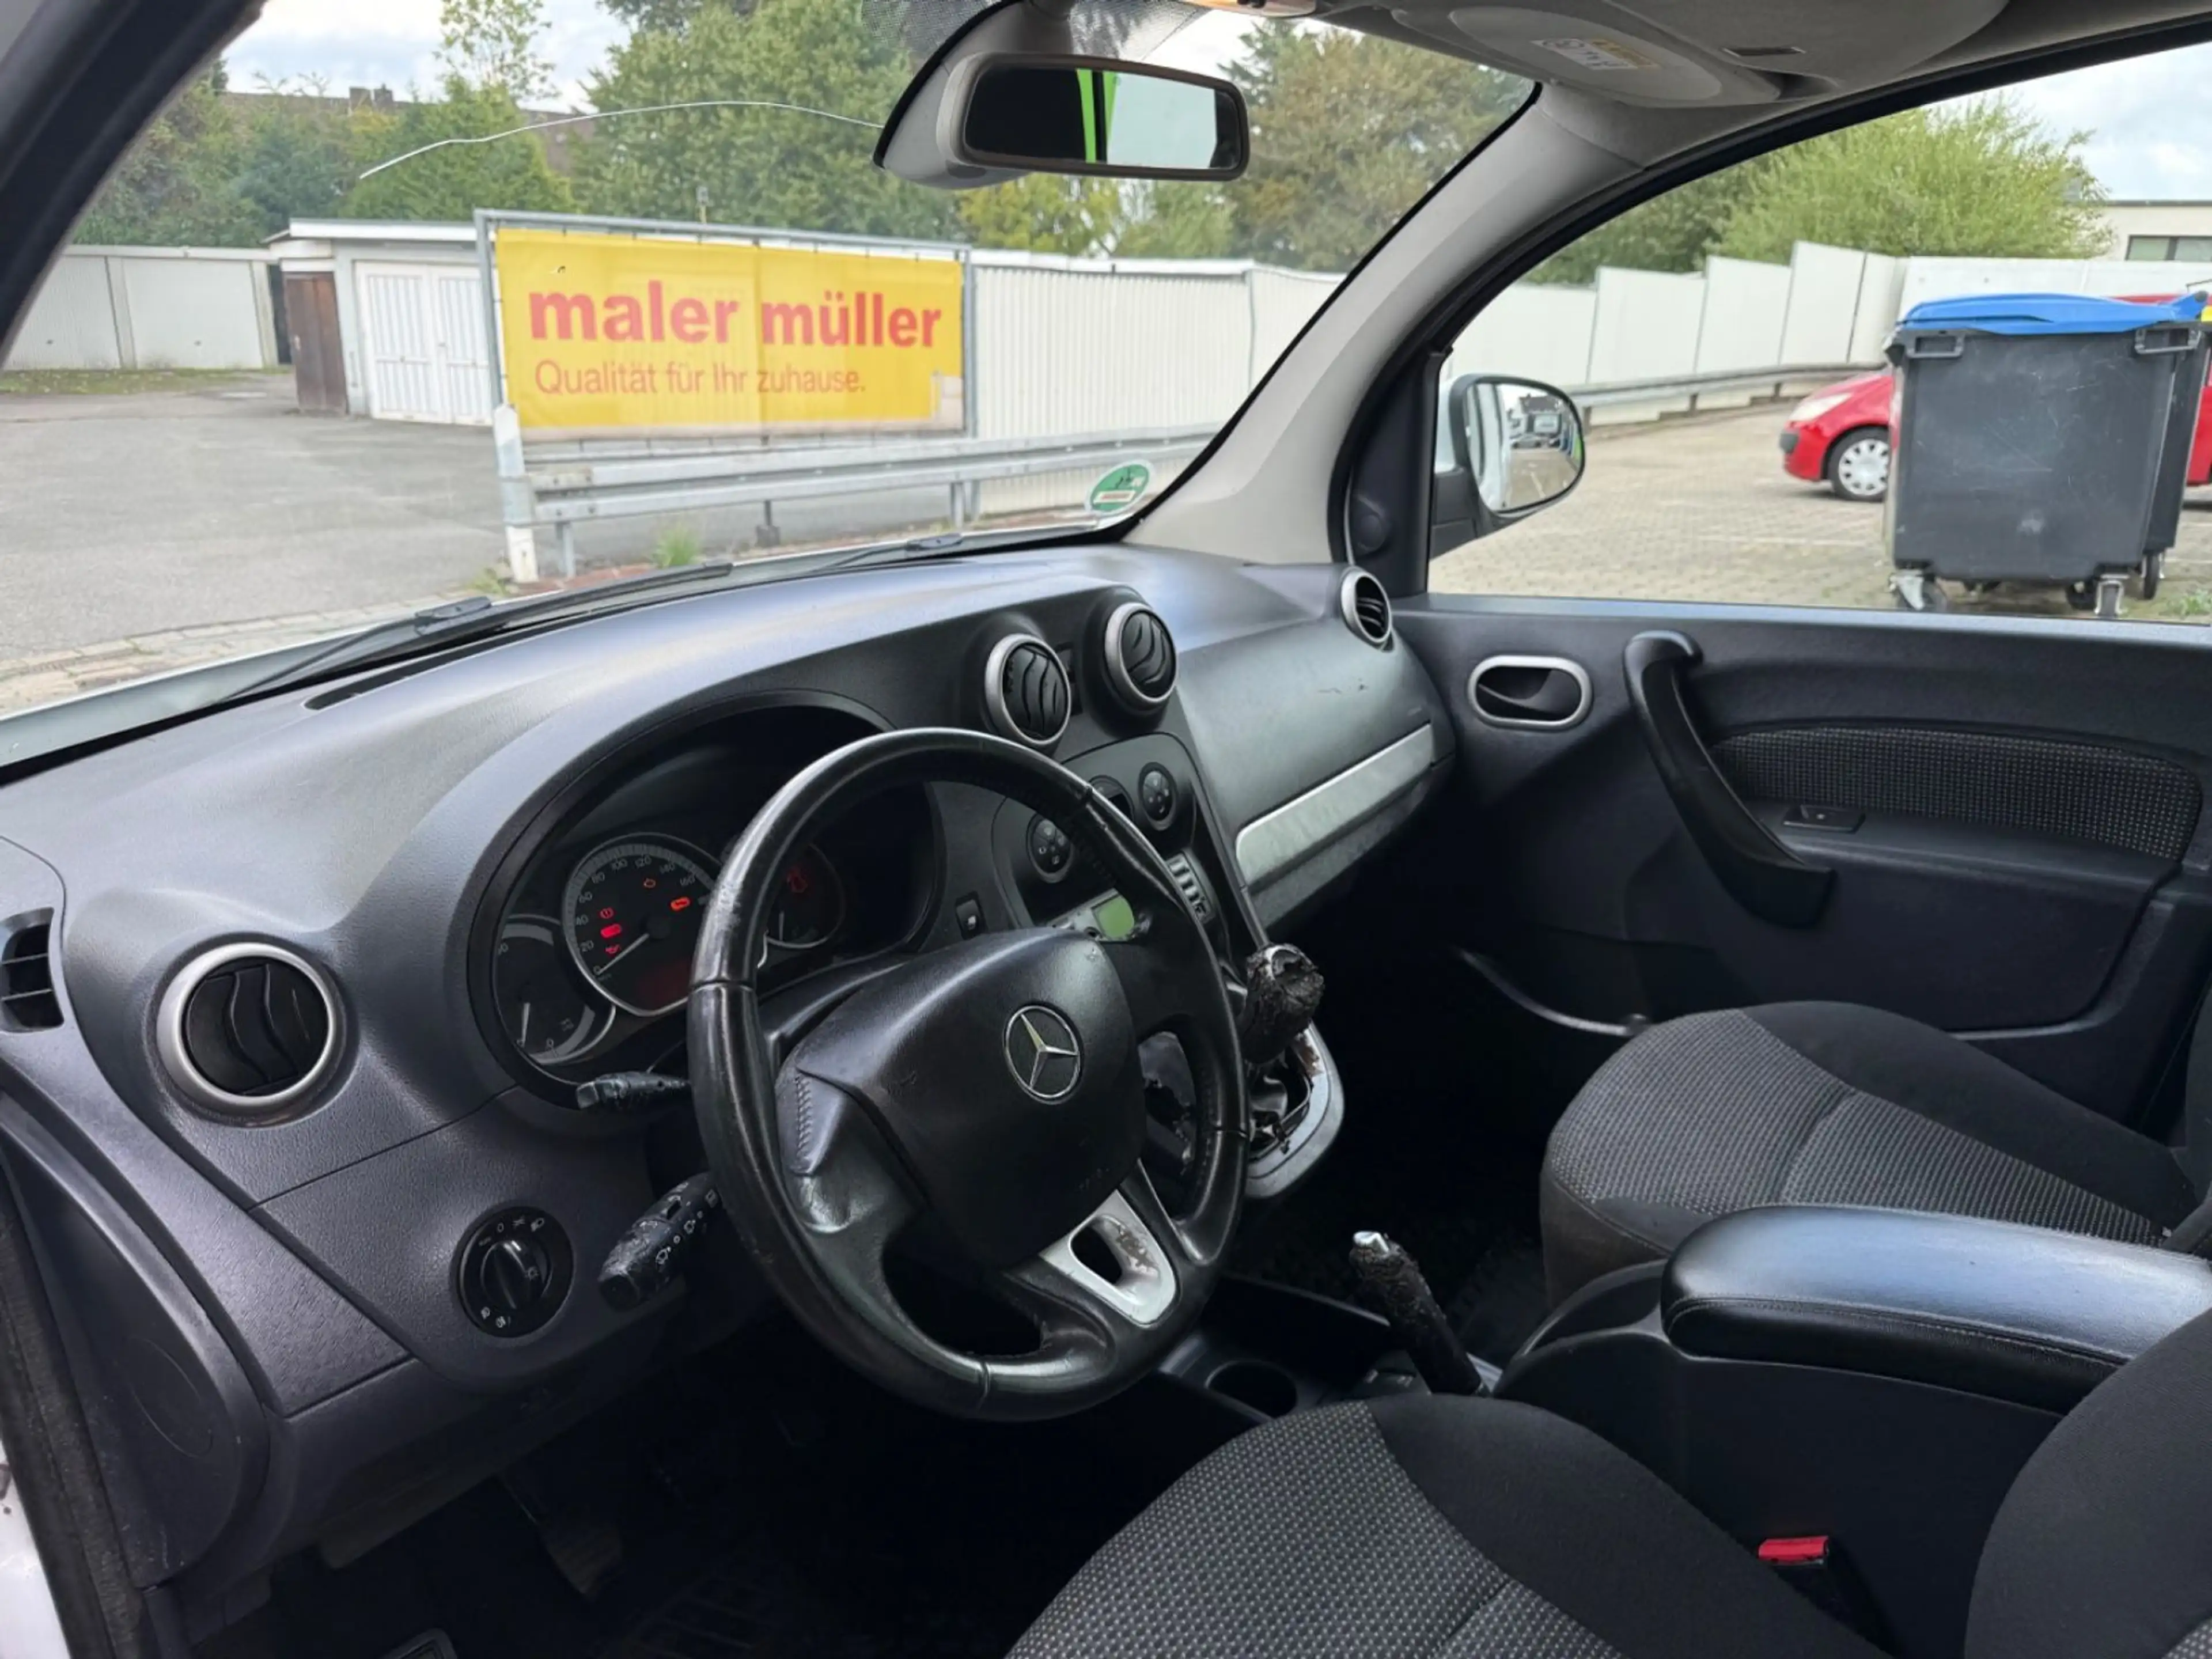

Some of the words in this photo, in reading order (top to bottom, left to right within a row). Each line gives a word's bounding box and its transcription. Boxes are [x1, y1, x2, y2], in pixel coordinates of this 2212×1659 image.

[529, 279, 740, 344] maler
[761, 290, 942, 347] müller
[535, 359, 658, 396] Qualität
[665, 361, 706, 394] für
[713, 361, 748, 394] Ihr
[756, 362, 866, 393] zuhause.
